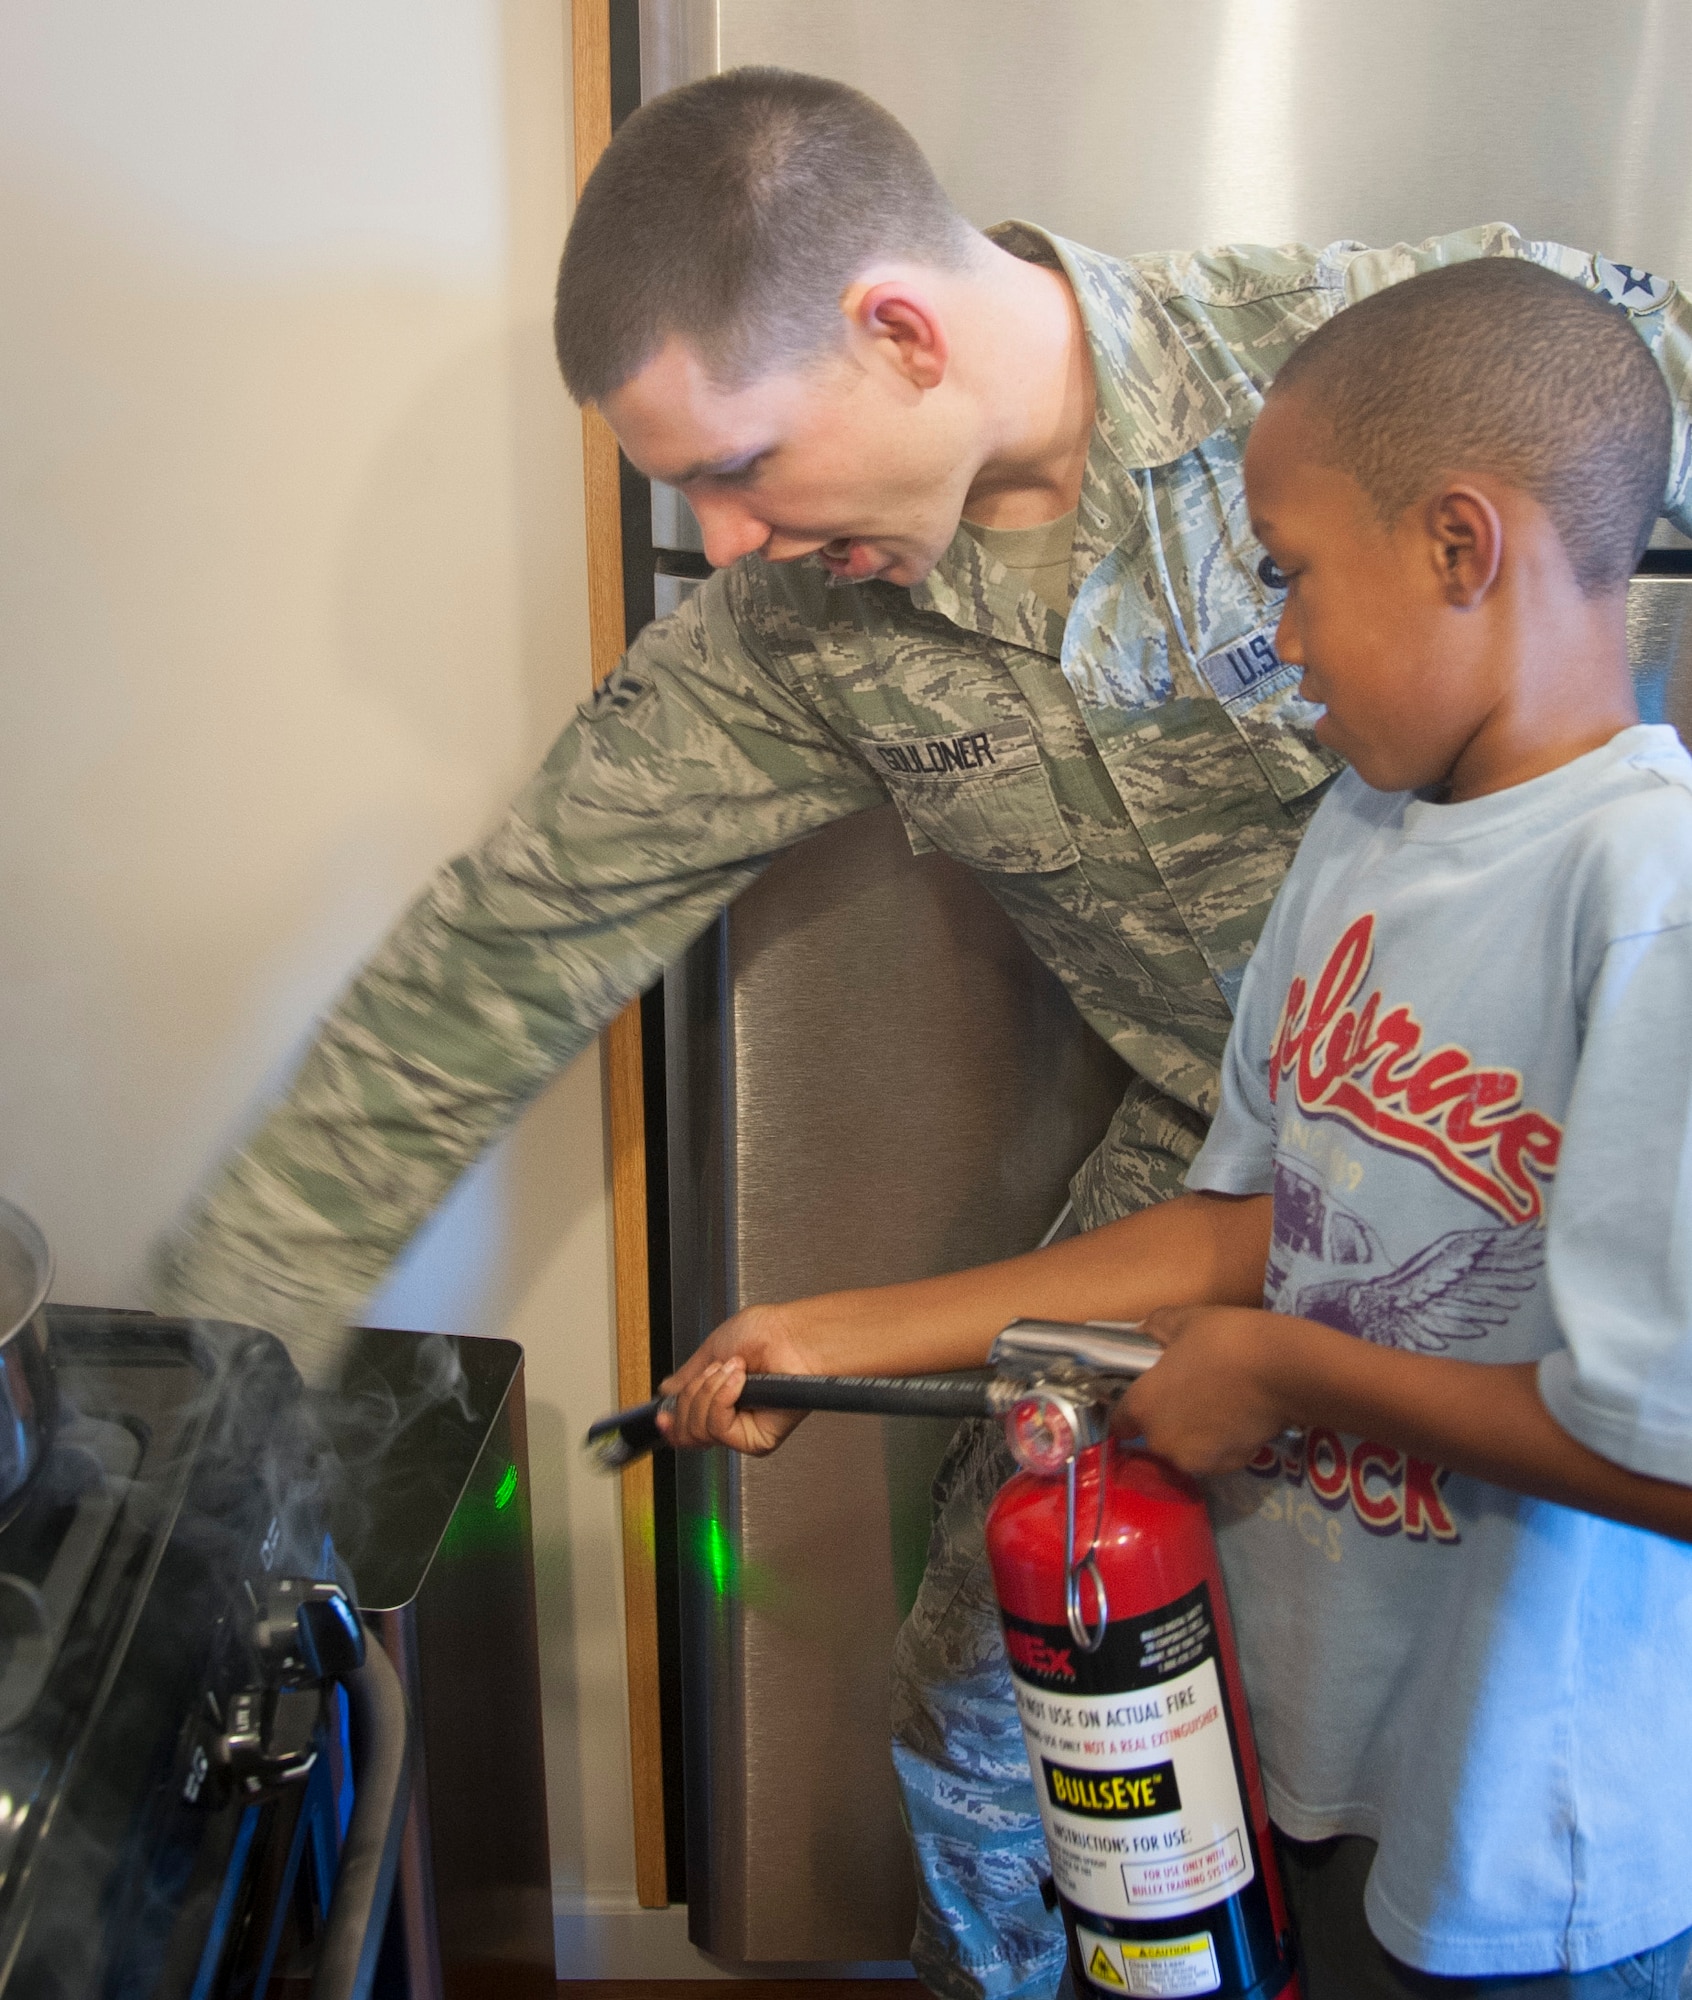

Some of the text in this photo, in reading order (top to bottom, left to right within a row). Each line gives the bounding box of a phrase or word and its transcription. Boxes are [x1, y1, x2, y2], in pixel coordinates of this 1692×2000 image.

[877, 731, 996, 773] GOULDNER
[1258, 1483, 1344, 1563] SICS
[1048, 1704, 1074, 1728] USE
[1078, 1709, 1101, 1729] ON
[1106, 1700, 1163, 1728] ACTUAL
[1166, 1685, 1197, 1715] FIRE
[1083, 1740, 1106, 1756] NOT
[1109, 1740, 1118, 1755] A
[1120, 1736, 1149, 1754] REAL
[1151, 1704, 1220, 1749] EXTINGUISHER
[1053, 1821, 1193, 1855] INSTRUCTIONS FOR USE:
[1143, 1847, 1226, 1881] FOR USE ONLY WITH
[1166, 1872, 1206, 1893] TRAINING
[1207, 1853, 1240, 1881] SYSTEMS
